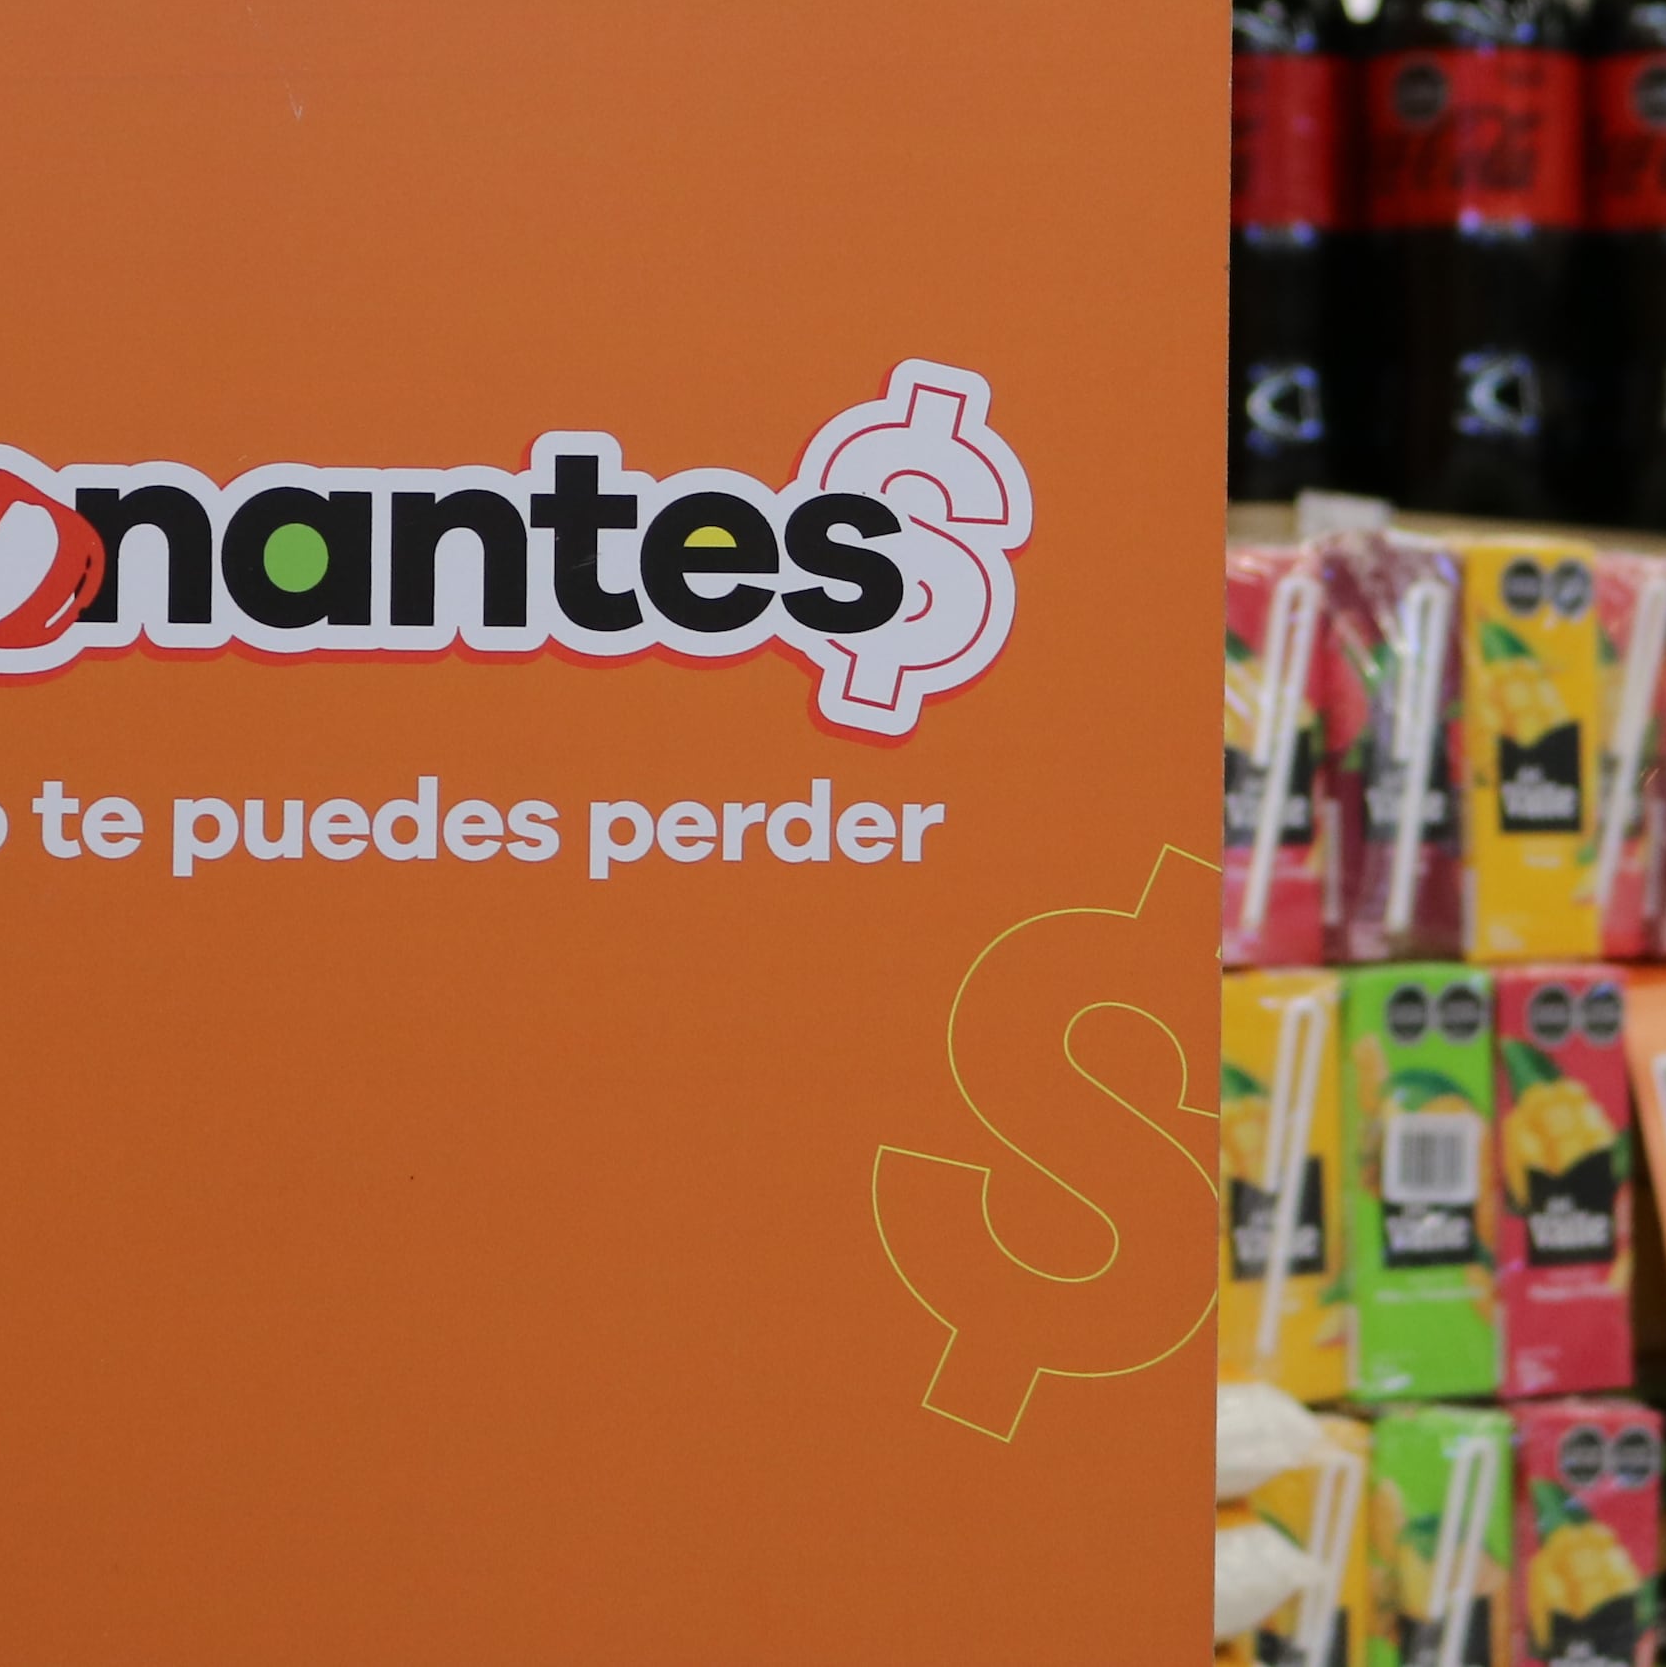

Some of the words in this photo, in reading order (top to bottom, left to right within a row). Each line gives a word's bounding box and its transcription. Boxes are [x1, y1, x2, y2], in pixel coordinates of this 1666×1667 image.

[31, 780, 143, 860] te
[171, 775, 560, 877] puedes
[589, 778, 945, 880] perder
